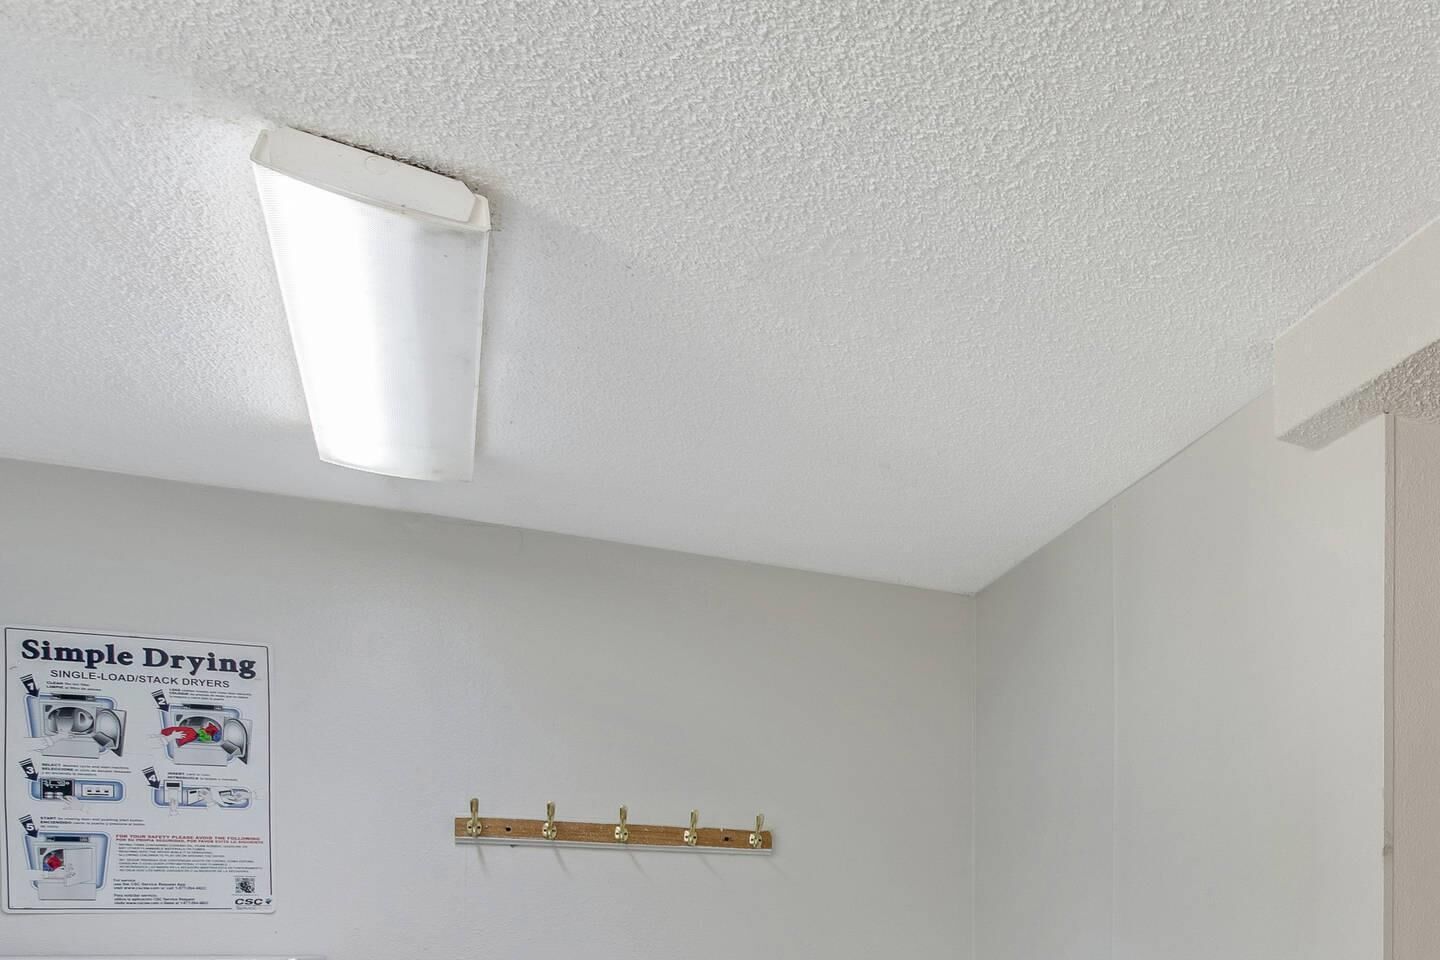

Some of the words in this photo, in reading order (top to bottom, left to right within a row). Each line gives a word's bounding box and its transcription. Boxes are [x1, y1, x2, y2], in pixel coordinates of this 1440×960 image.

[21, 638, 134, 670] Simple
[142, 647, 257, 680] Drying
[50, 669, 179, 685] SINGLE-LOAD/STACK
[182, 677, 230, 689] DRYERS
[157, 697, 166, 705] 2
[25, 766, 34, 775] 3
[26, 823, 34, 831] 5
[235, 897, 263, 906] CSC
